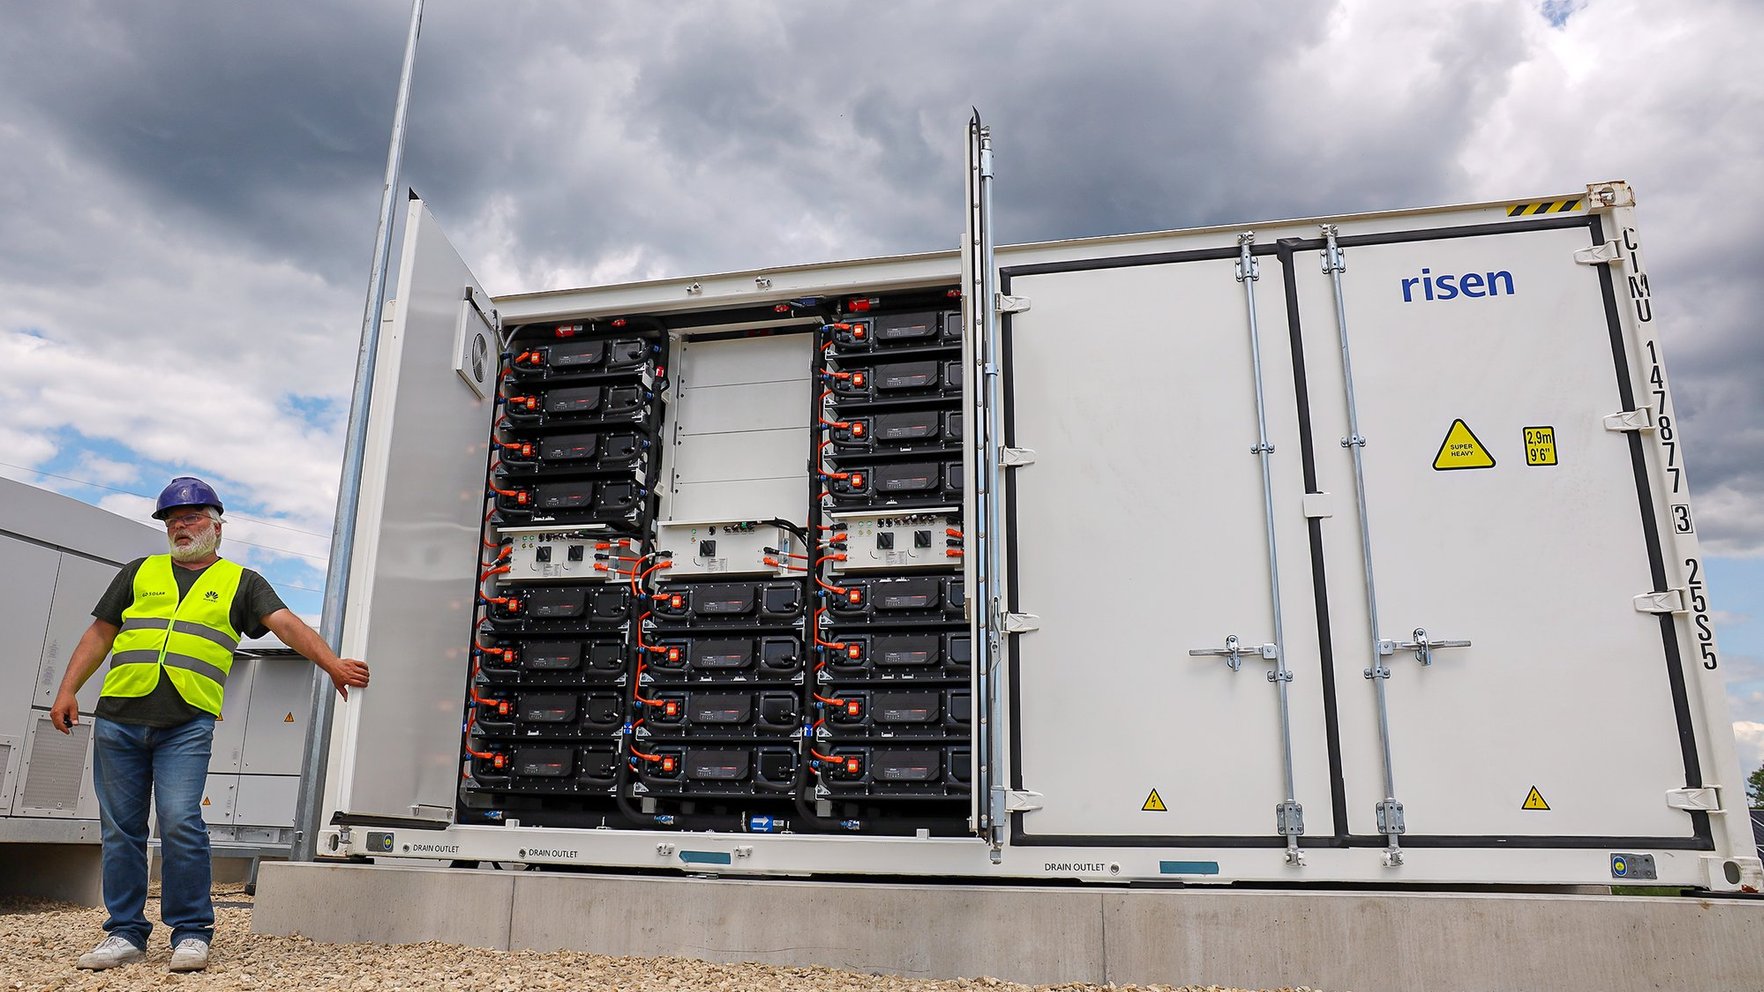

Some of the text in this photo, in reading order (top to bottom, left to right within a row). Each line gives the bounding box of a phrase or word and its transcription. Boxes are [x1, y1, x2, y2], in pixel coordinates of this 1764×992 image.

[1401, 267, 1515, 303] risen
[1527, 431, 1552, 446] 2,9m
[1450, 443, 1473, 451] SUPER
[1623, 227, 1718, 670] CIMU 147877 3 25S5
[413, 844, 460, 853] DRAIN OUTLET
[528, 848, 578, 858] DRAIN OUTLET
[1044, 863, 1105, 871] DRAIN OUTLET
